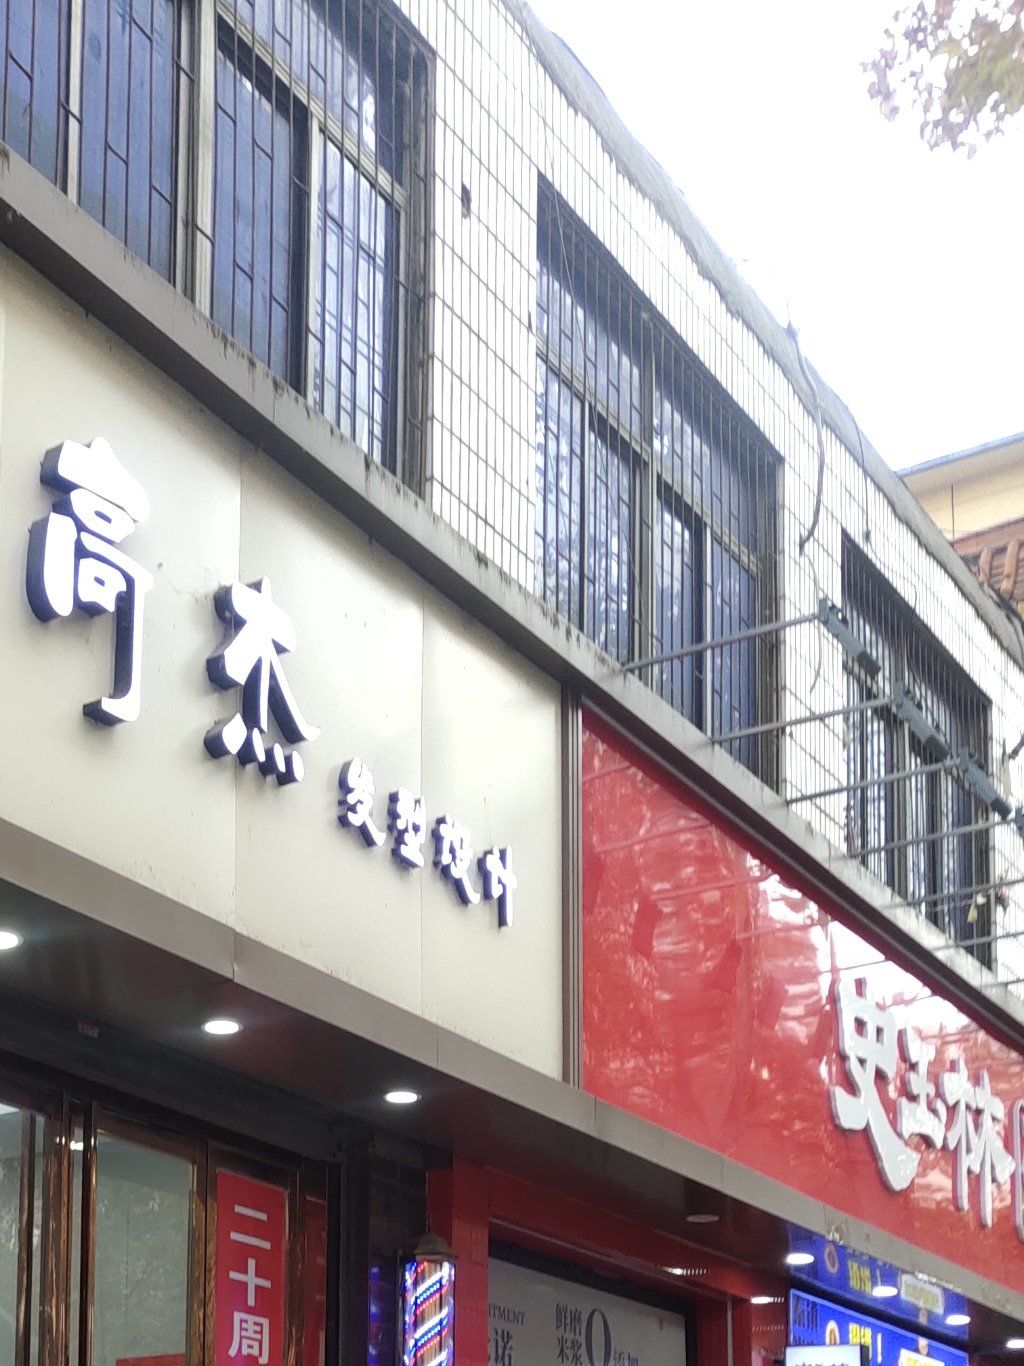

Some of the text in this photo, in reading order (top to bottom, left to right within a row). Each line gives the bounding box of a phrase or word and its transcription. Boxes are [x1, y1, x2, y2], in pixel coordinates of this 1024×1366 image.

[26, 437, 517, 927] 高杰 发型设计
